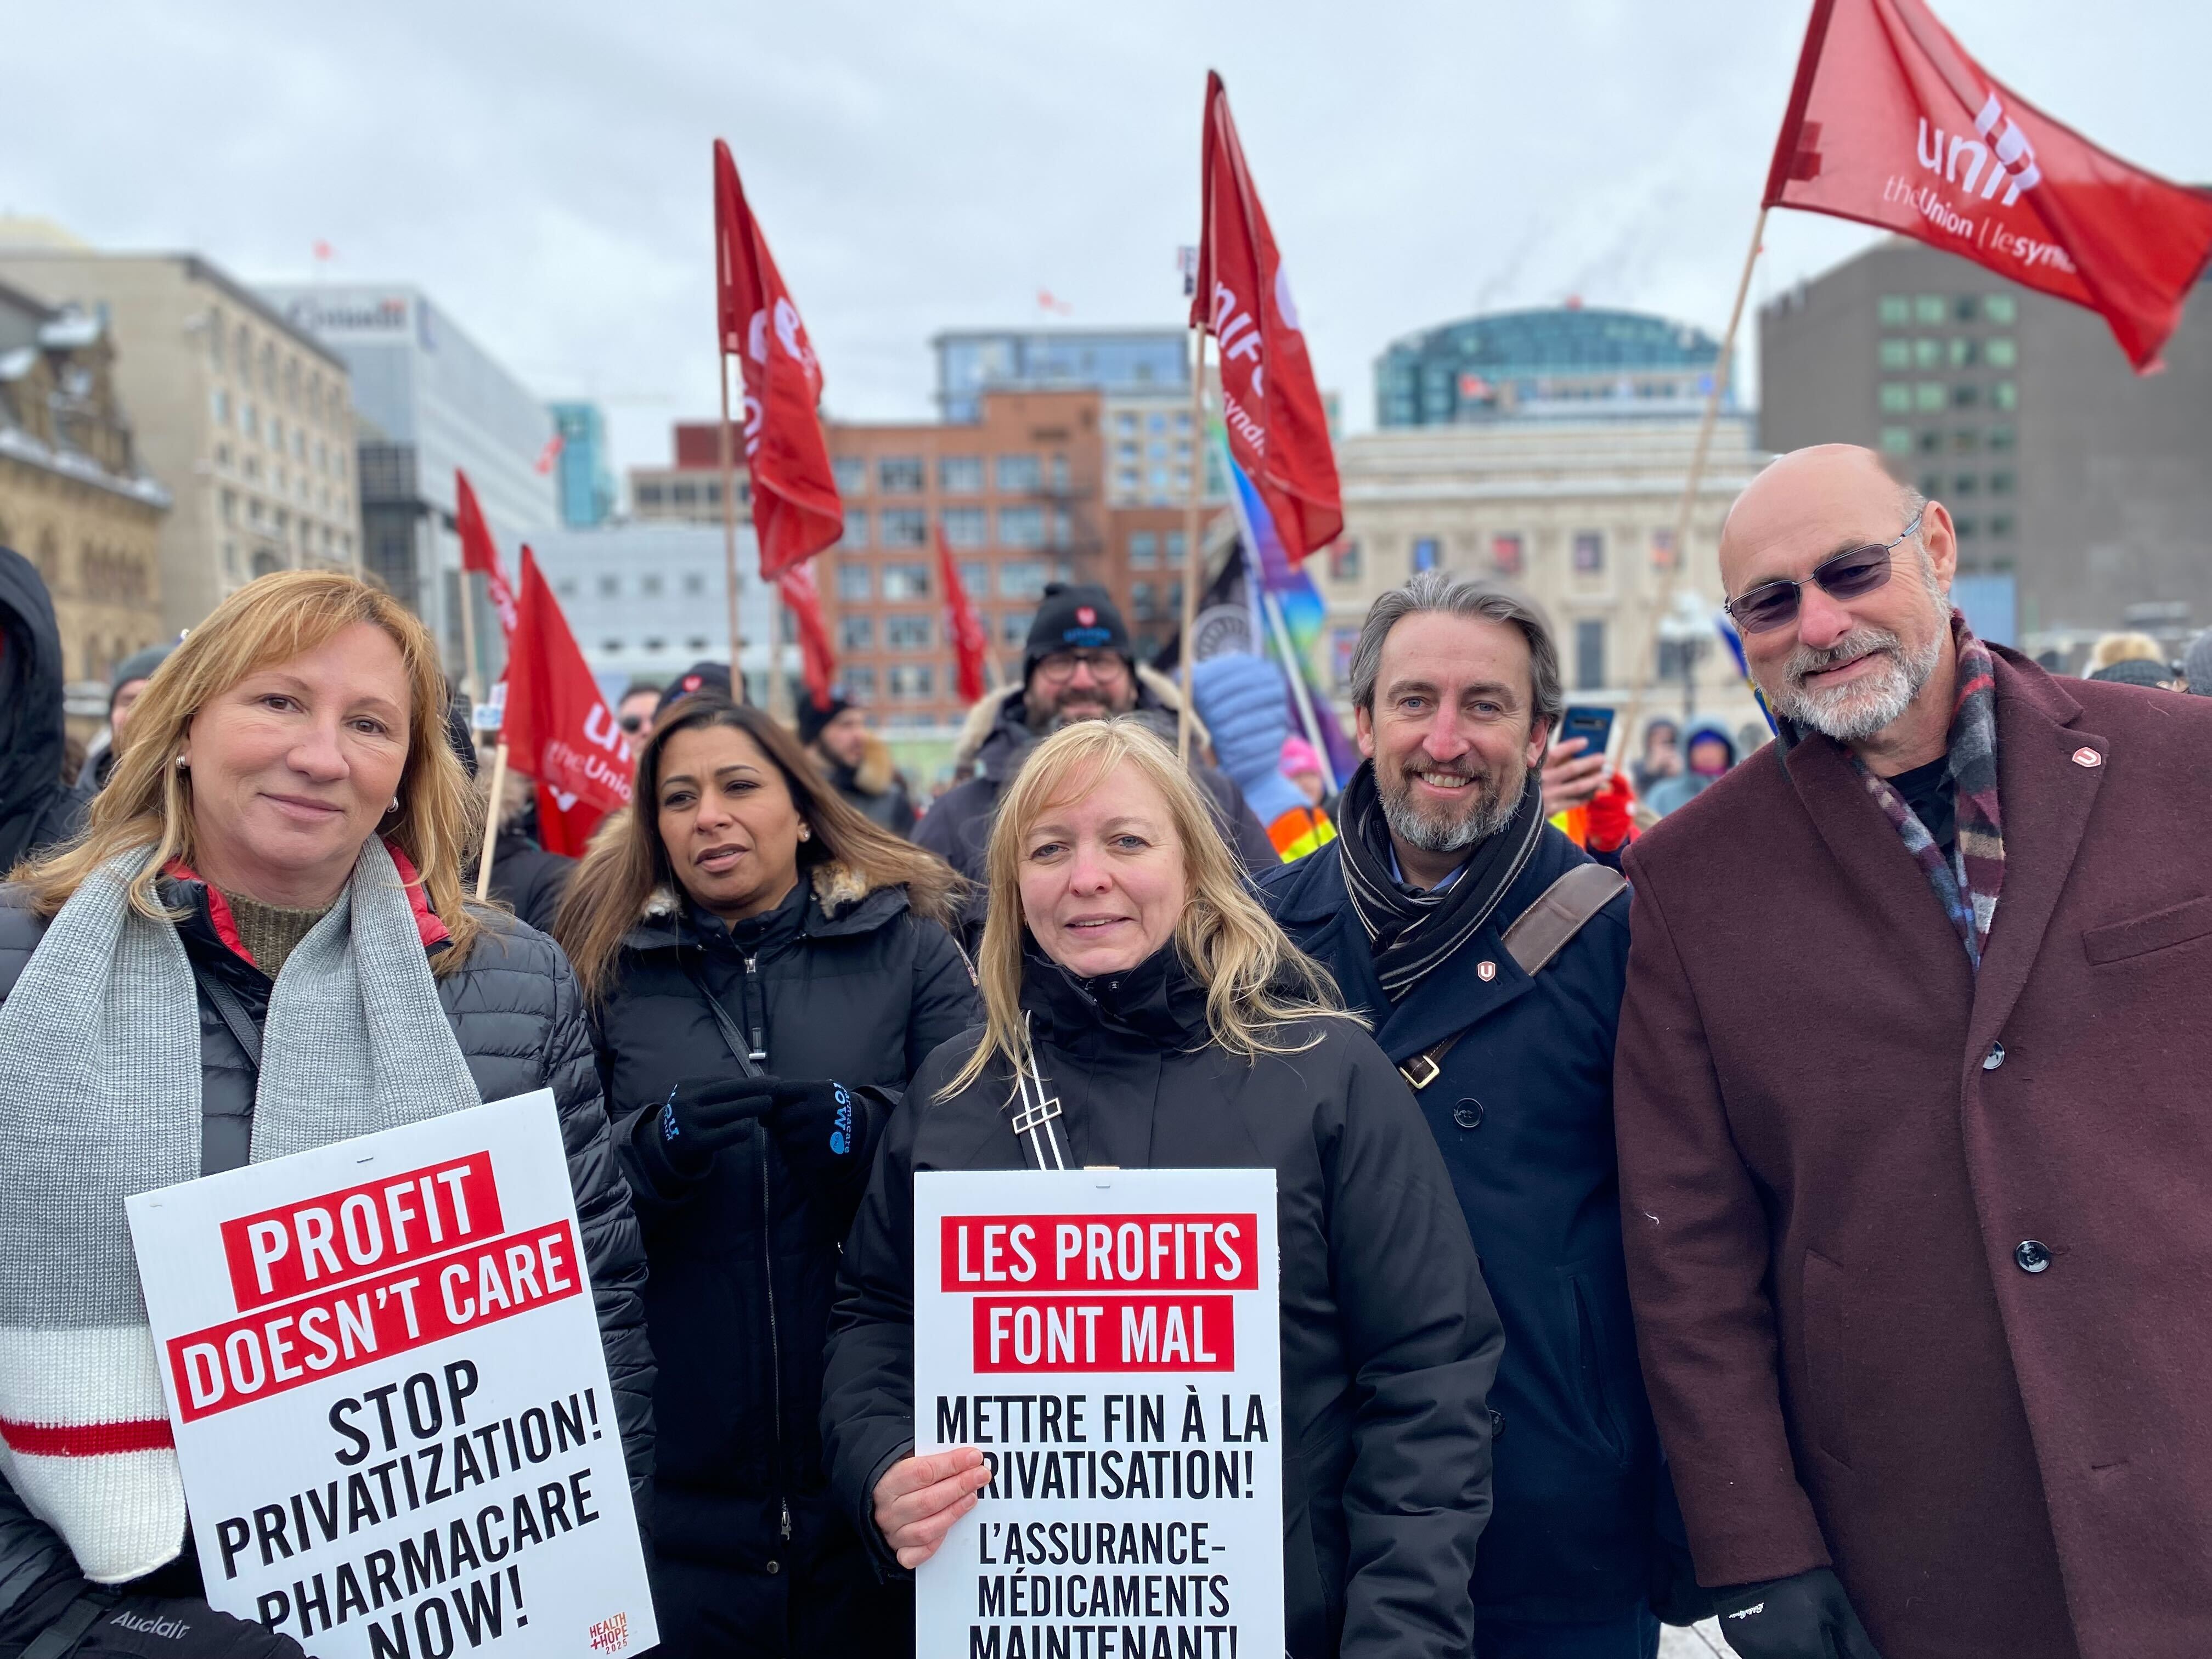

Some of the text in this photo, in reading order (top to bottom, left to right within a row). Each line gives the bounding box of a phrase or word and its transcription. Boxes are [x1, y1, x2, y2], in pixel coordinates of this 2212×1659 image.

[1481, 965, 1492, 978] U
[247, 1165, 471, 1295] PROFIT
[958, 1222, 1242, 1282] LES PROFITS
[182, 1233, 571, 1409] DOESN'T CARE
[990, 1306, 1216, 1364] FONT MAL
[328, 1359, 479, 1466] STOP
[936, 1385, 1268, 1444] METTRE FIN À LA
[216, 1388, 602, 1581] PRIVATIZATION!
[977, 1449, 1253, 1500] RIVATISATION!
[256, 1468, 599, 1638] PHARMACARE
[367, 1564, 528, 1659] NOW!
[978, 1567, 1229, 1618] MÉDICAMENTS
[110, 1610, 193, 1640] Auclair
[589, 1612, 627, 1639] HEALTH
[605, 1638, 628, 1655] 2025
[969, 1625, 1237, 1659] MAINTENANT!
